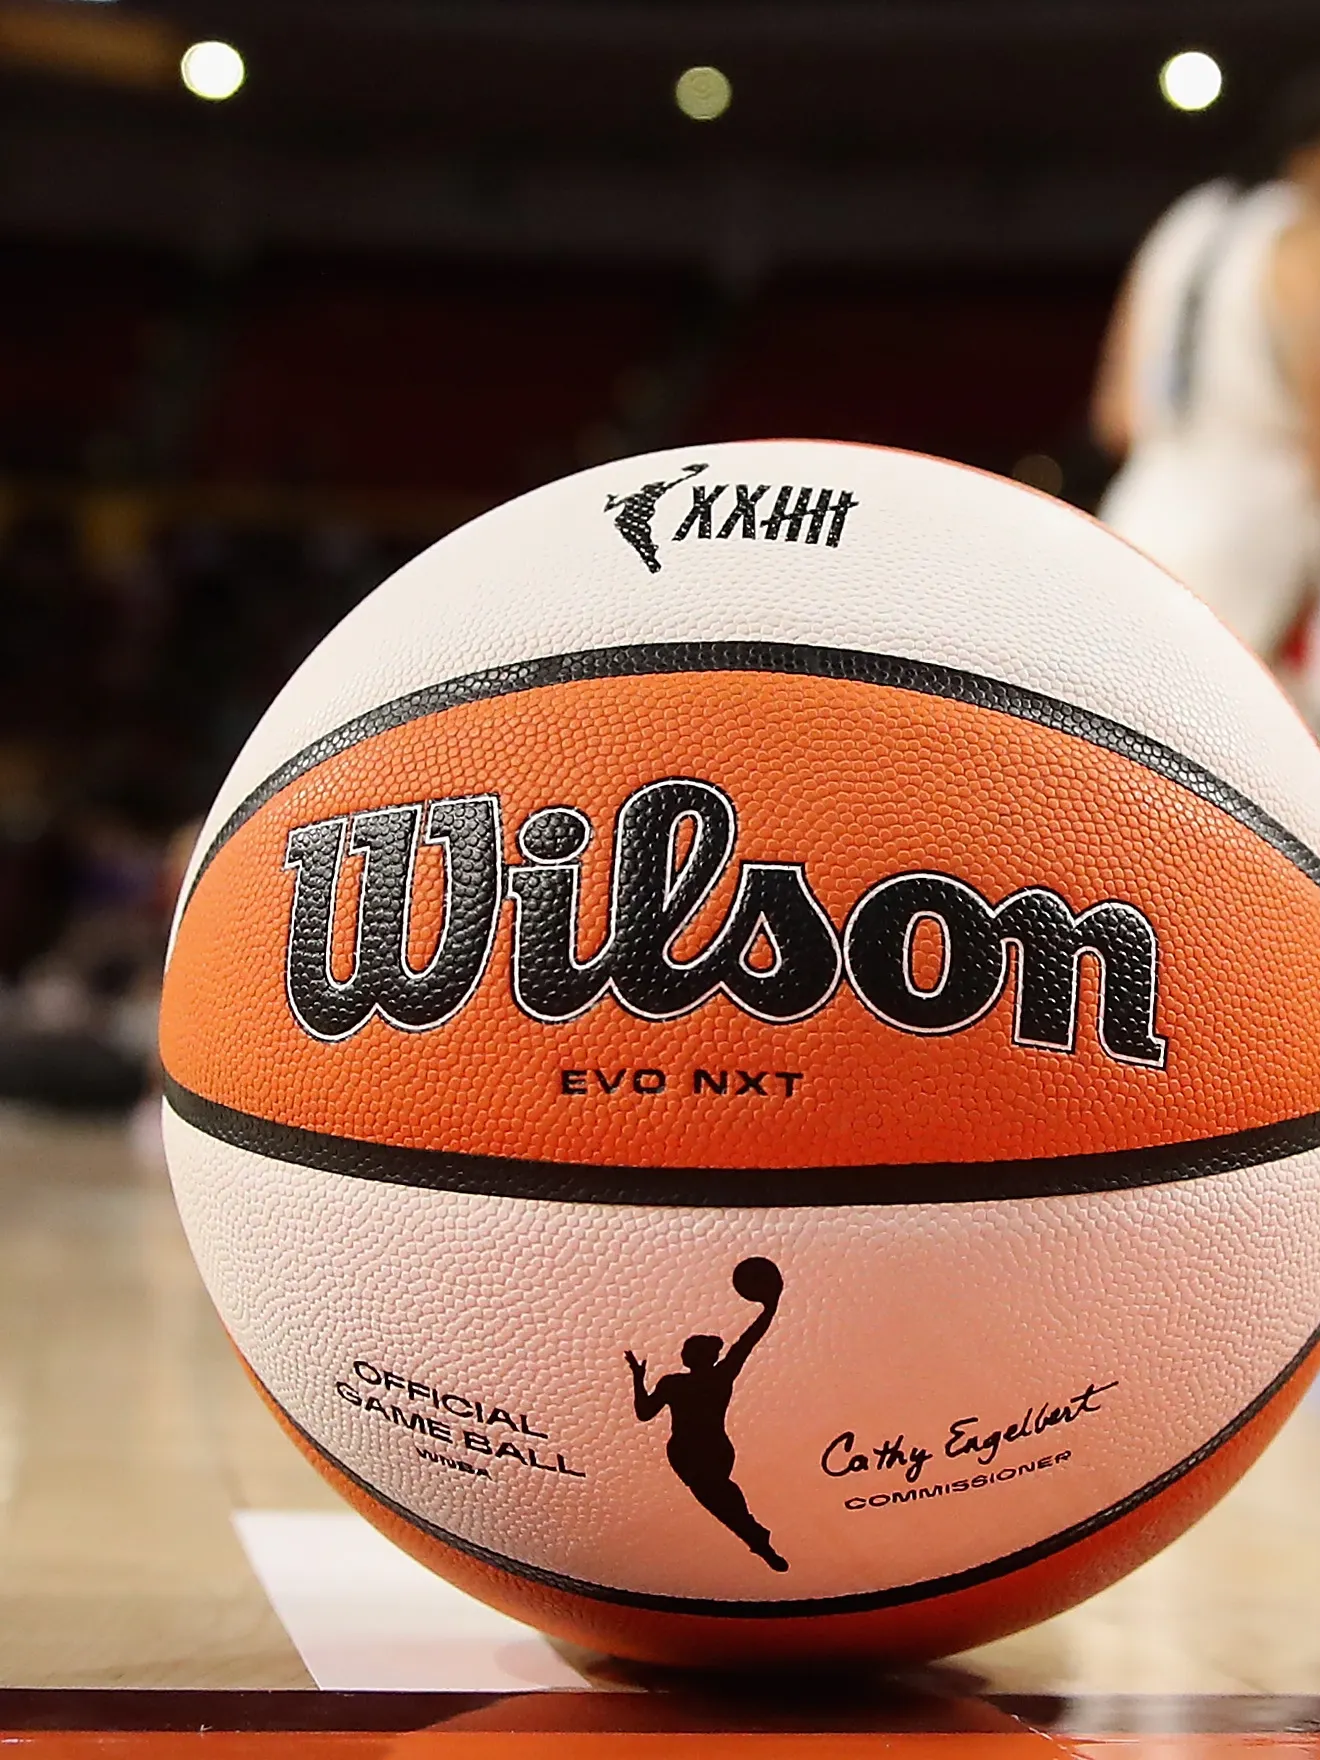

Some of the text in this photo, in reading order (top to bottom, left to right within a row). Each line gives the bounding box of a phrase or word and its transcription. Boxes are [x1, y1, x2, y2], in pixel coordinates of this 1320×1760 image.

[282, 775, 1168, 1070] Wilson
[561, 1069, 803, 1097] EVO NXT
[337, 1381, 586, 1477] GAME BALL
[353, 1361, 548, 1439] OFFICIAL
[821, 1381, 1119, 1482] Cathy Engelbert
[415, 1446, 493, 1480] WNBA
[844, 1450, 1072, 1510] COMMISSIONER
